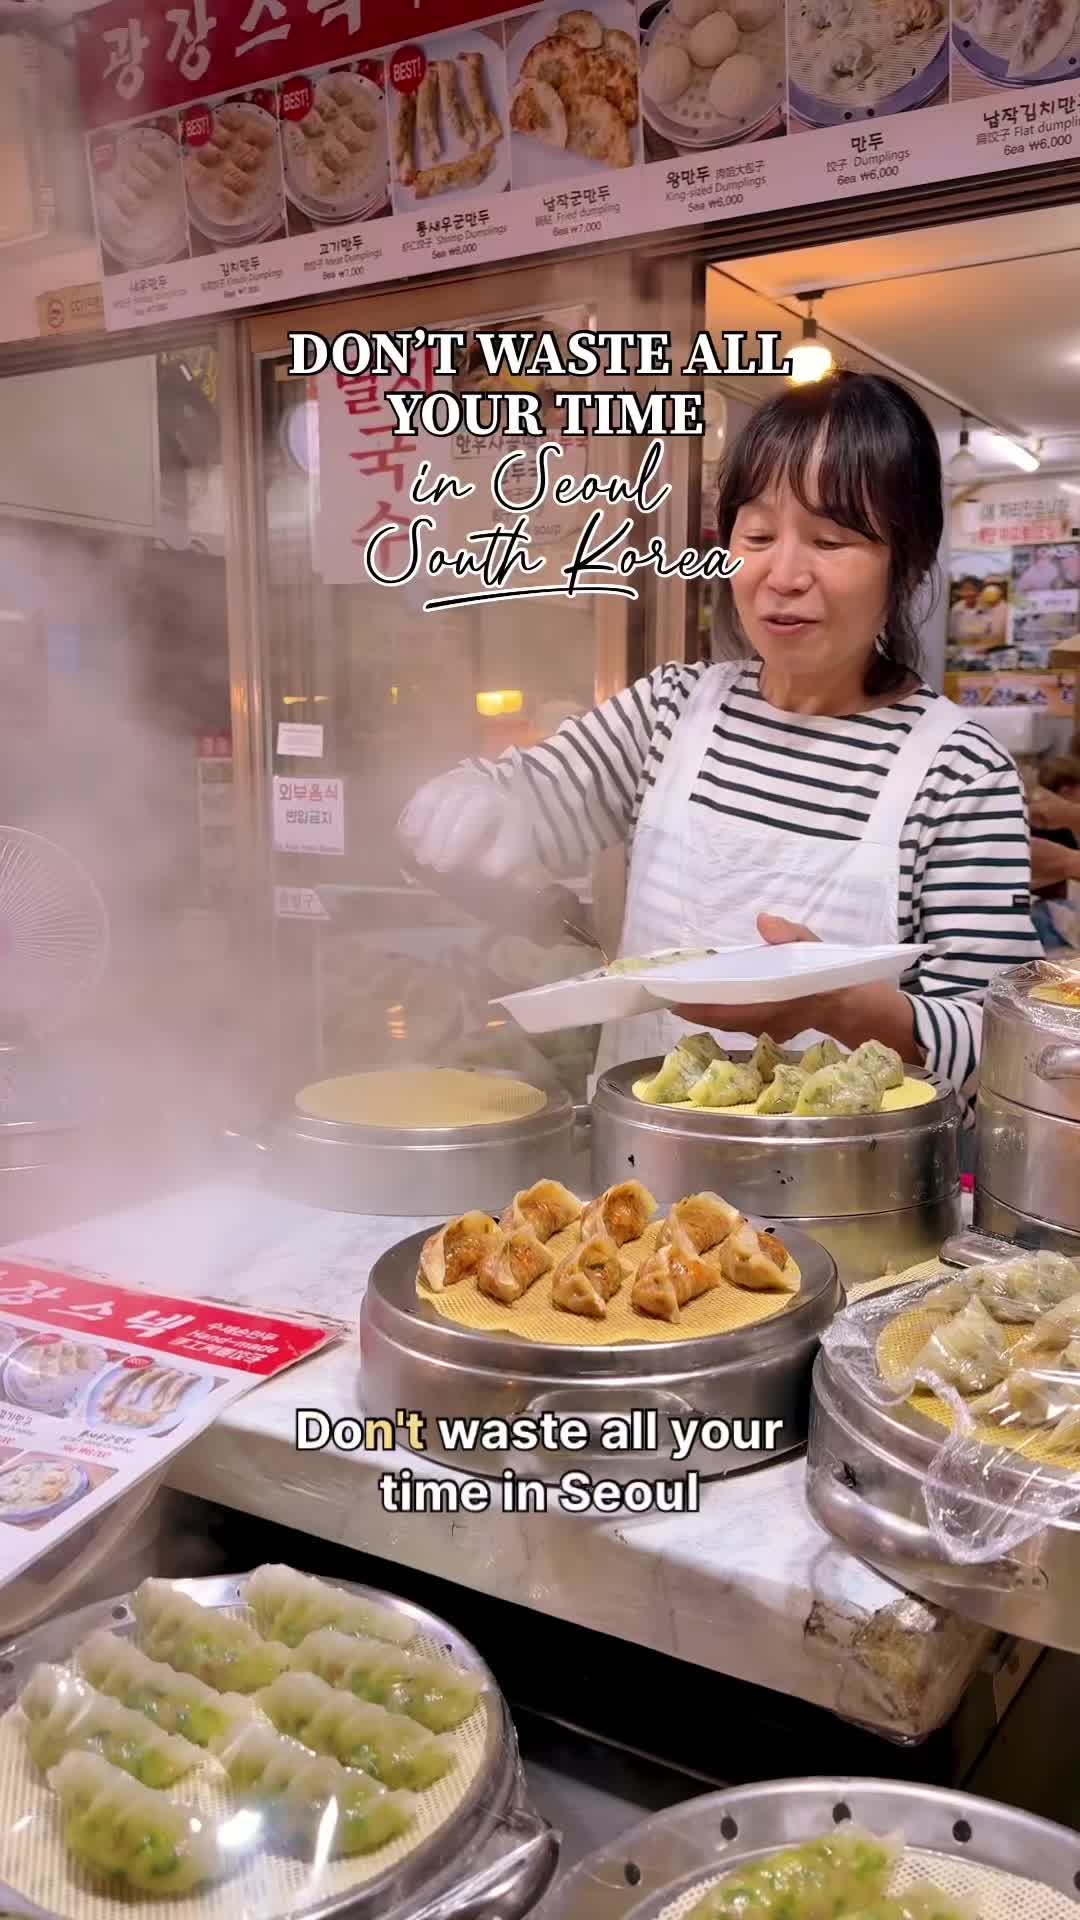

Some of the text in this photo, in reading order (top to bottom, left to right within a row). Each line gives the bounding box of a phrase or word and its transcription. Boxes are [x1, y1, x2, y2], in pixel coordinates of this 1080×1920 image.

[392, 57, 422, 81] BEST!
[283, 89, 310, 111] BEST!
[983, 95, 1080, 129] 납작김치만
[186, 115, 210, 137] BEST!
[1014, 125, 1035, 137] Flat
[1037, 115, 1080, 133] dumpli
[851, 132, 884, 153] 만두
[1003, 144, 1025, 156] 6ea
[854, 149, 910, 167] Dumplings
[666, 166, 711, 189] 왕만두
[715, 176, 767, 193] Dumplings
[837, 174, 857, 186] 6ea
[543, 185, 611, 212] 납작군만두
[416, 209, 490, 238] 통새우군만두
[319, 235, 363, 255] 고기만두
[186, 1329, 279, 1355] Hand-made
